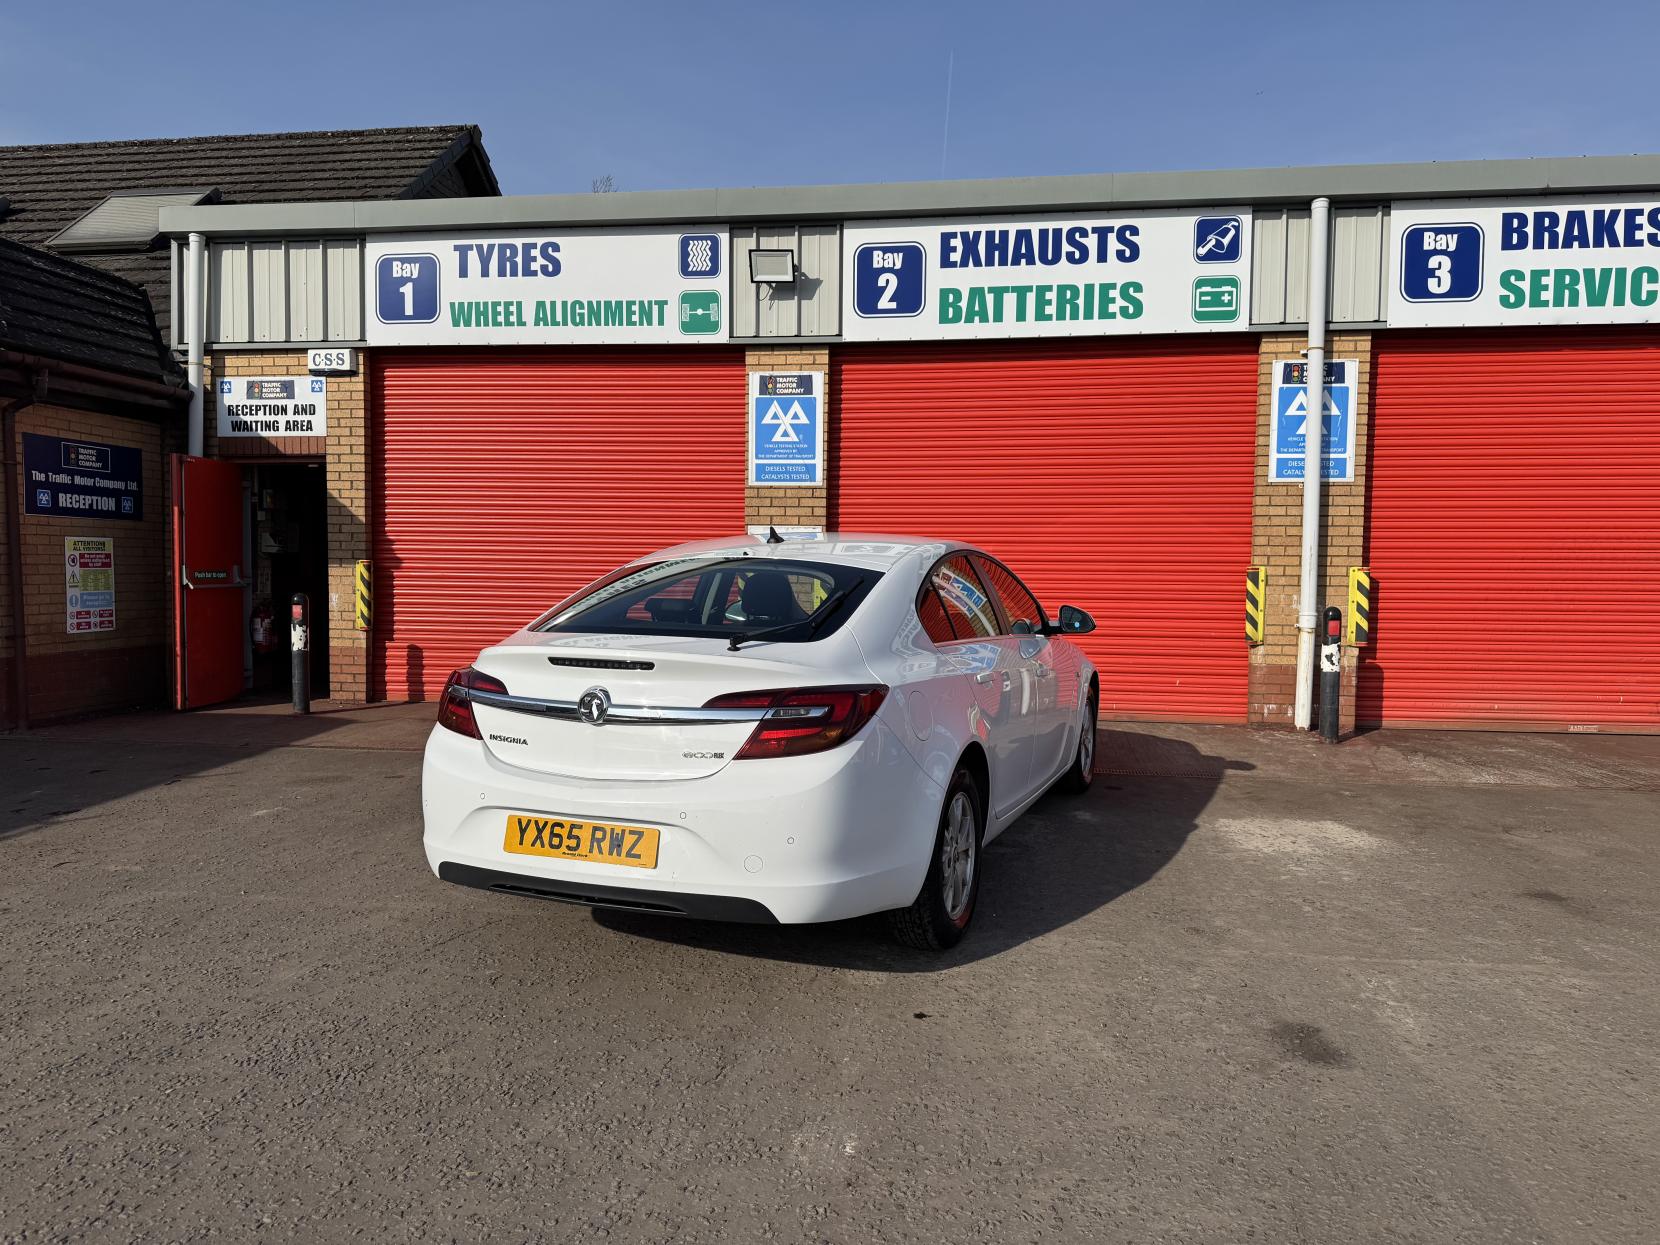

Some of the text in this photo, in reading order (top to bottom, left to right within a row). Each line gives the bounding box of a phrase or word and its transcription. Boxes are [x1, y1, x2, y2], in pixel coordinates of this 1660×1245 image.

[939, 224, 1141, 269] EXHAUSTS
[1423, 231, 1458, 251] Bay
[392, 261, 420, 279] Bay
[453, 241, 562, 278] TYRES
[872, 250, 903, 269] Bay
[1427, 254, 1452, 294] 3
[399, 282, 413, 316] 1
[877, 272, 899, 310] 2
[938, 281, 1144, 325] BATTERIES
[449, 299, 669, 328] WHEEL ALIGNMENT
[227, 403, 316, 417] RECEPTION AND
[231, 420, 313, 432] WAITING AREA
[31, 470, 139, 491] The Traffic Motor Company Ltd.
[58, 493, 116, 511] RECEPTION
[489, 733, 529, 746] INSIGNIA
[517, 817, 646, 860] YX65 RWZ
